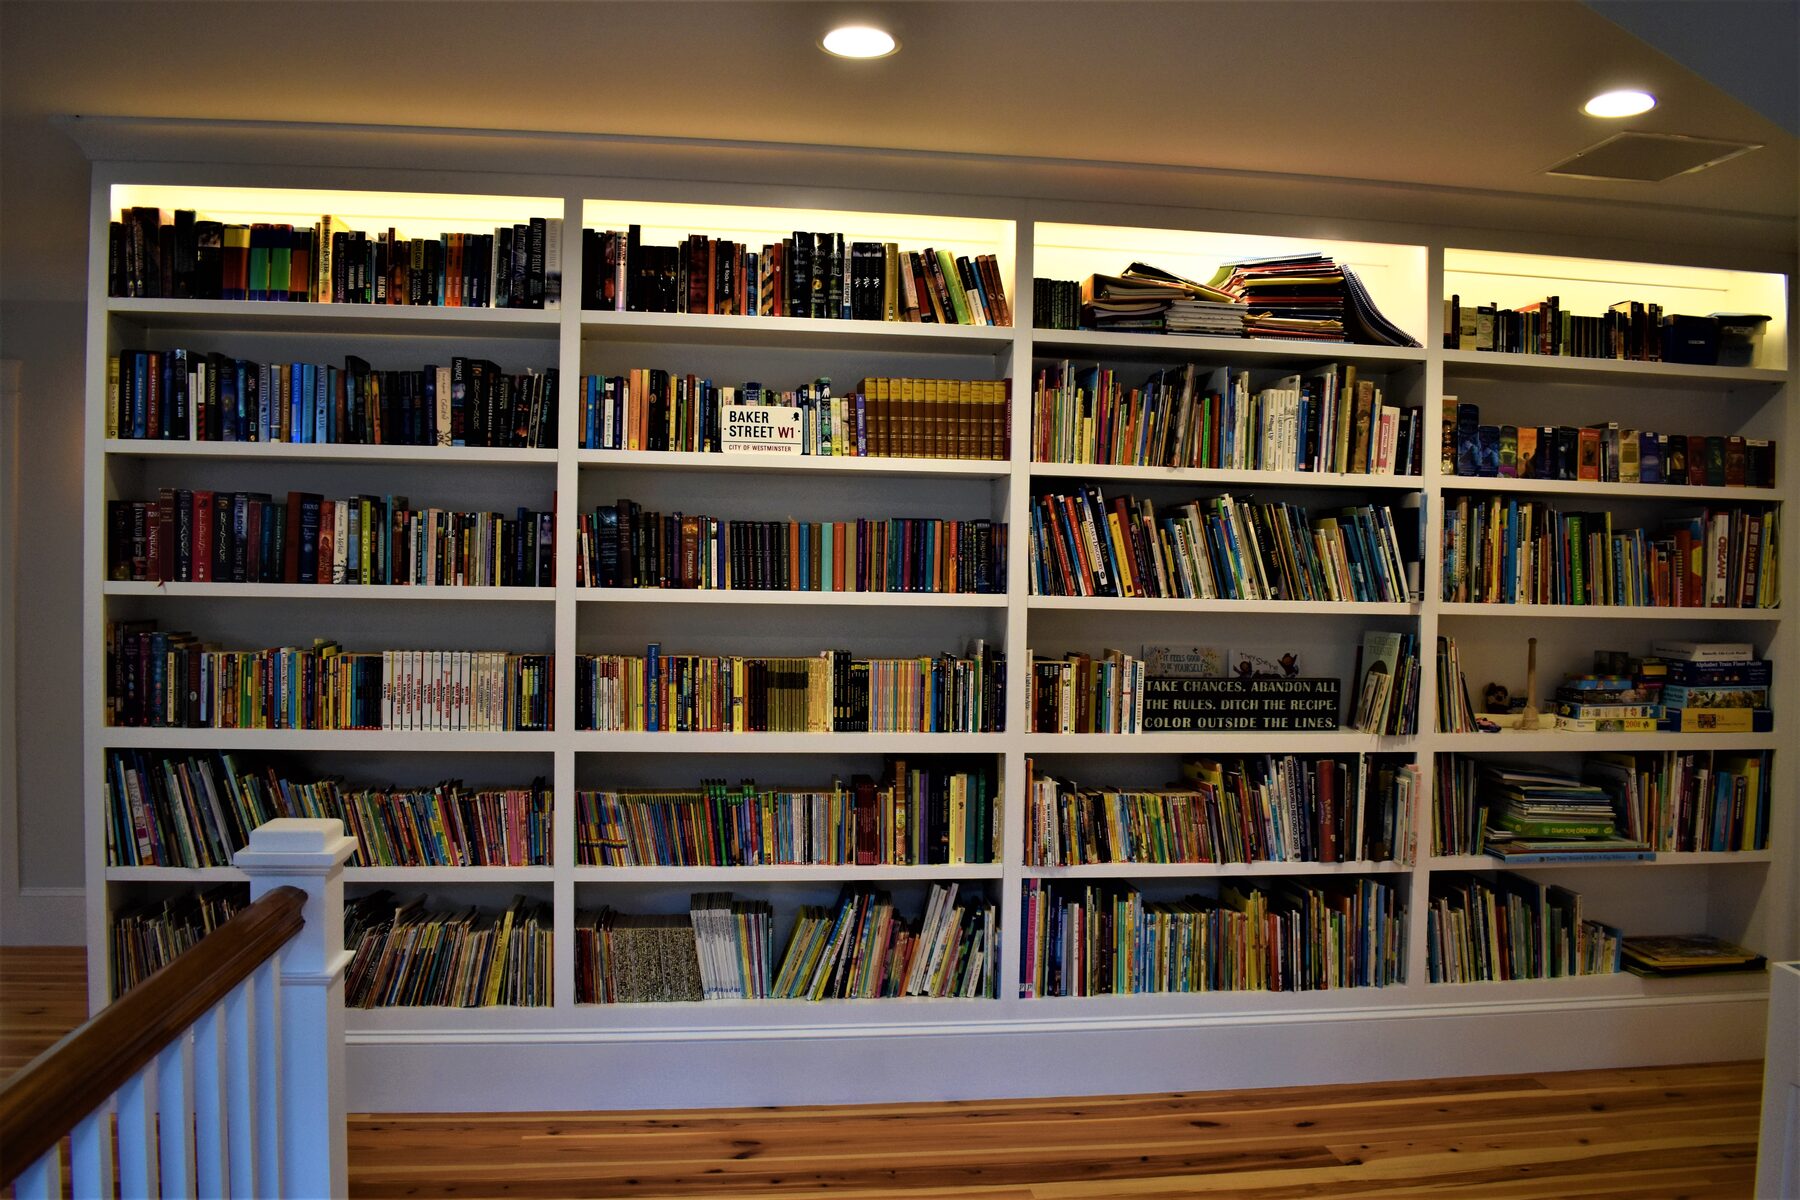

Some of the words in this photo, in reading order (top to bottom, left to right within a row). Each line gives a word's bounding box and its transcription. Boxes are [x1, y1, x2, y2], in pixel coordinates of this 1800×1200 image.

[532, 223, 541, 252] MATTHEW
[532, 254, 541, 273] REILLY
[730, 411, 768, 422] BAKER
[730, 426, 773, 438] STREET
[778, 426, 794, 438] W1
[134, 508, 144, 536] INKDEATH
[180, 509, 189, 557] ERAGON
[979, 531, 989, 558] Dragon
[1717, 537, 1727, 579] ORIGAMI
[1747, 547, 1756, 570] DRAW
[1146, 682, 1178, 692] TAKE
[1183, 682, 1246, 692] CHANCES.
[1251, 682, 1310, 692] ABANDON
[1315, 682, 1337, 692] ALL
[1146, 700, 1168, 710] THE
[1174, 700, 1216, 710] RULES.
[1221, 700, 1258, 710] DITCH
[1262, 700, 1286, 710] THE
[1291, 700, 1336, 710] RECIPE.
[1145, 717, 1191, 728] COLOR
[1198, 717, 1257, 728] OUTSIDE
[1264, 717, 1288, 728] THE
[1295, 717, 1335, 728] LINES.
[1286, 759, 1295, 788] GUINNESS
[1288, 788, 1297, 809] WORLD
[1290, 810, 1298, 836] RECORDS
